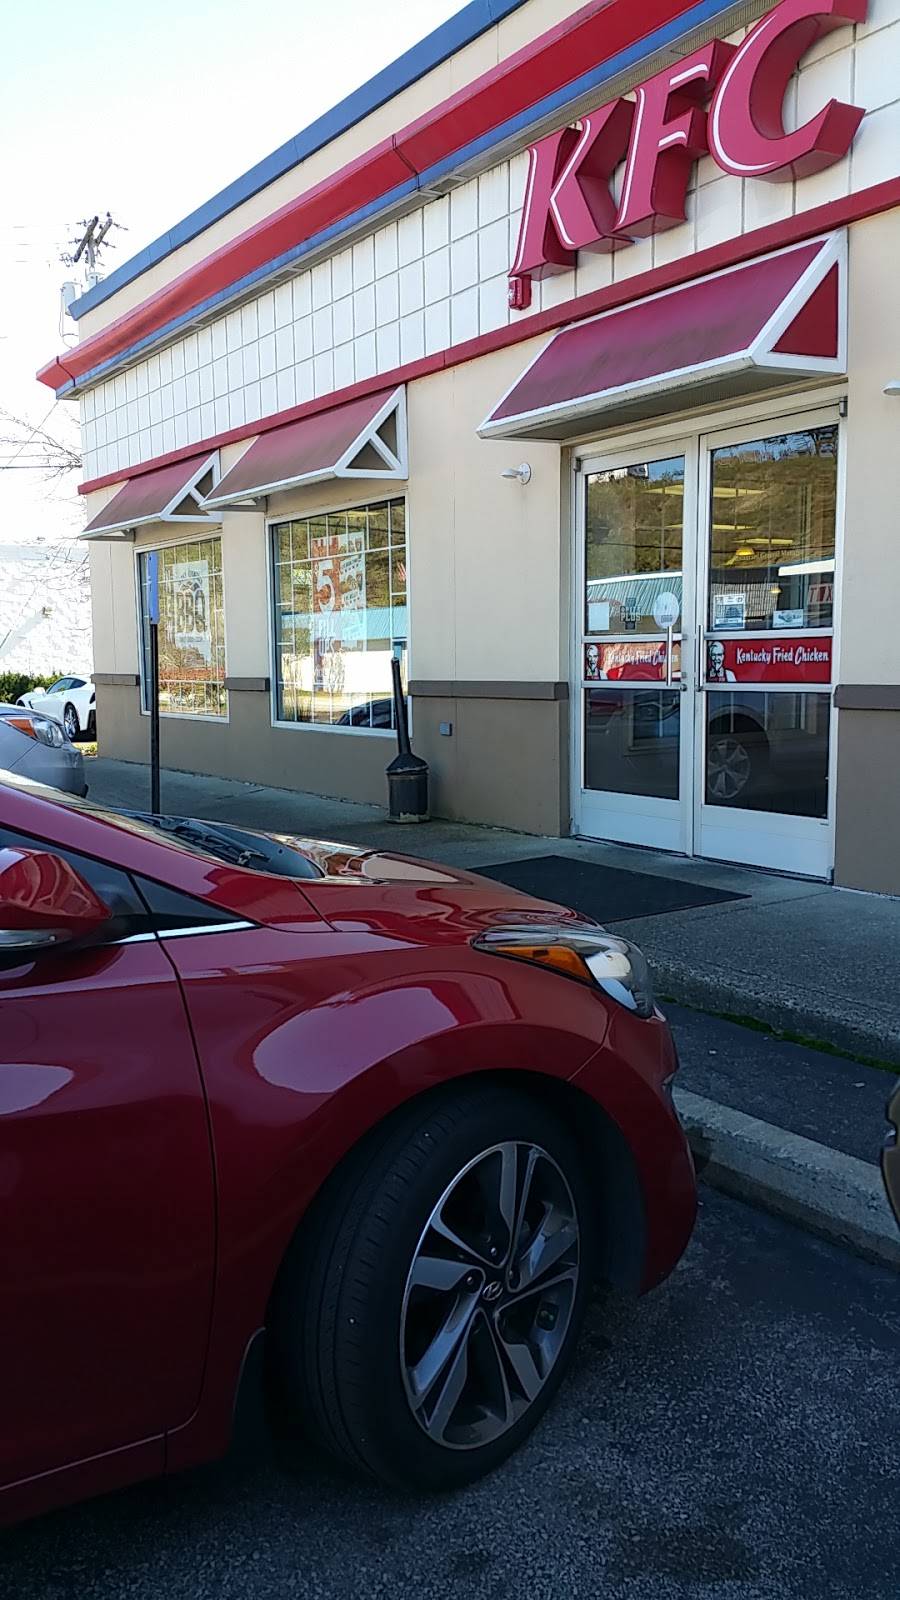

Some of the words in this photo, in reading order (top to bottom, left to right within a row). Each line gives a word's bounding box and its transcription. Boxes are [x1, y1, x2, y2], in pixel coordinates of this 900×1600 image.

[509, 0, 866, 281] KFC
[736, 647, 770, 665] Kentucky
[773, 647, 793, 664] Fried
[795, 646, 829, 665] Chicken
